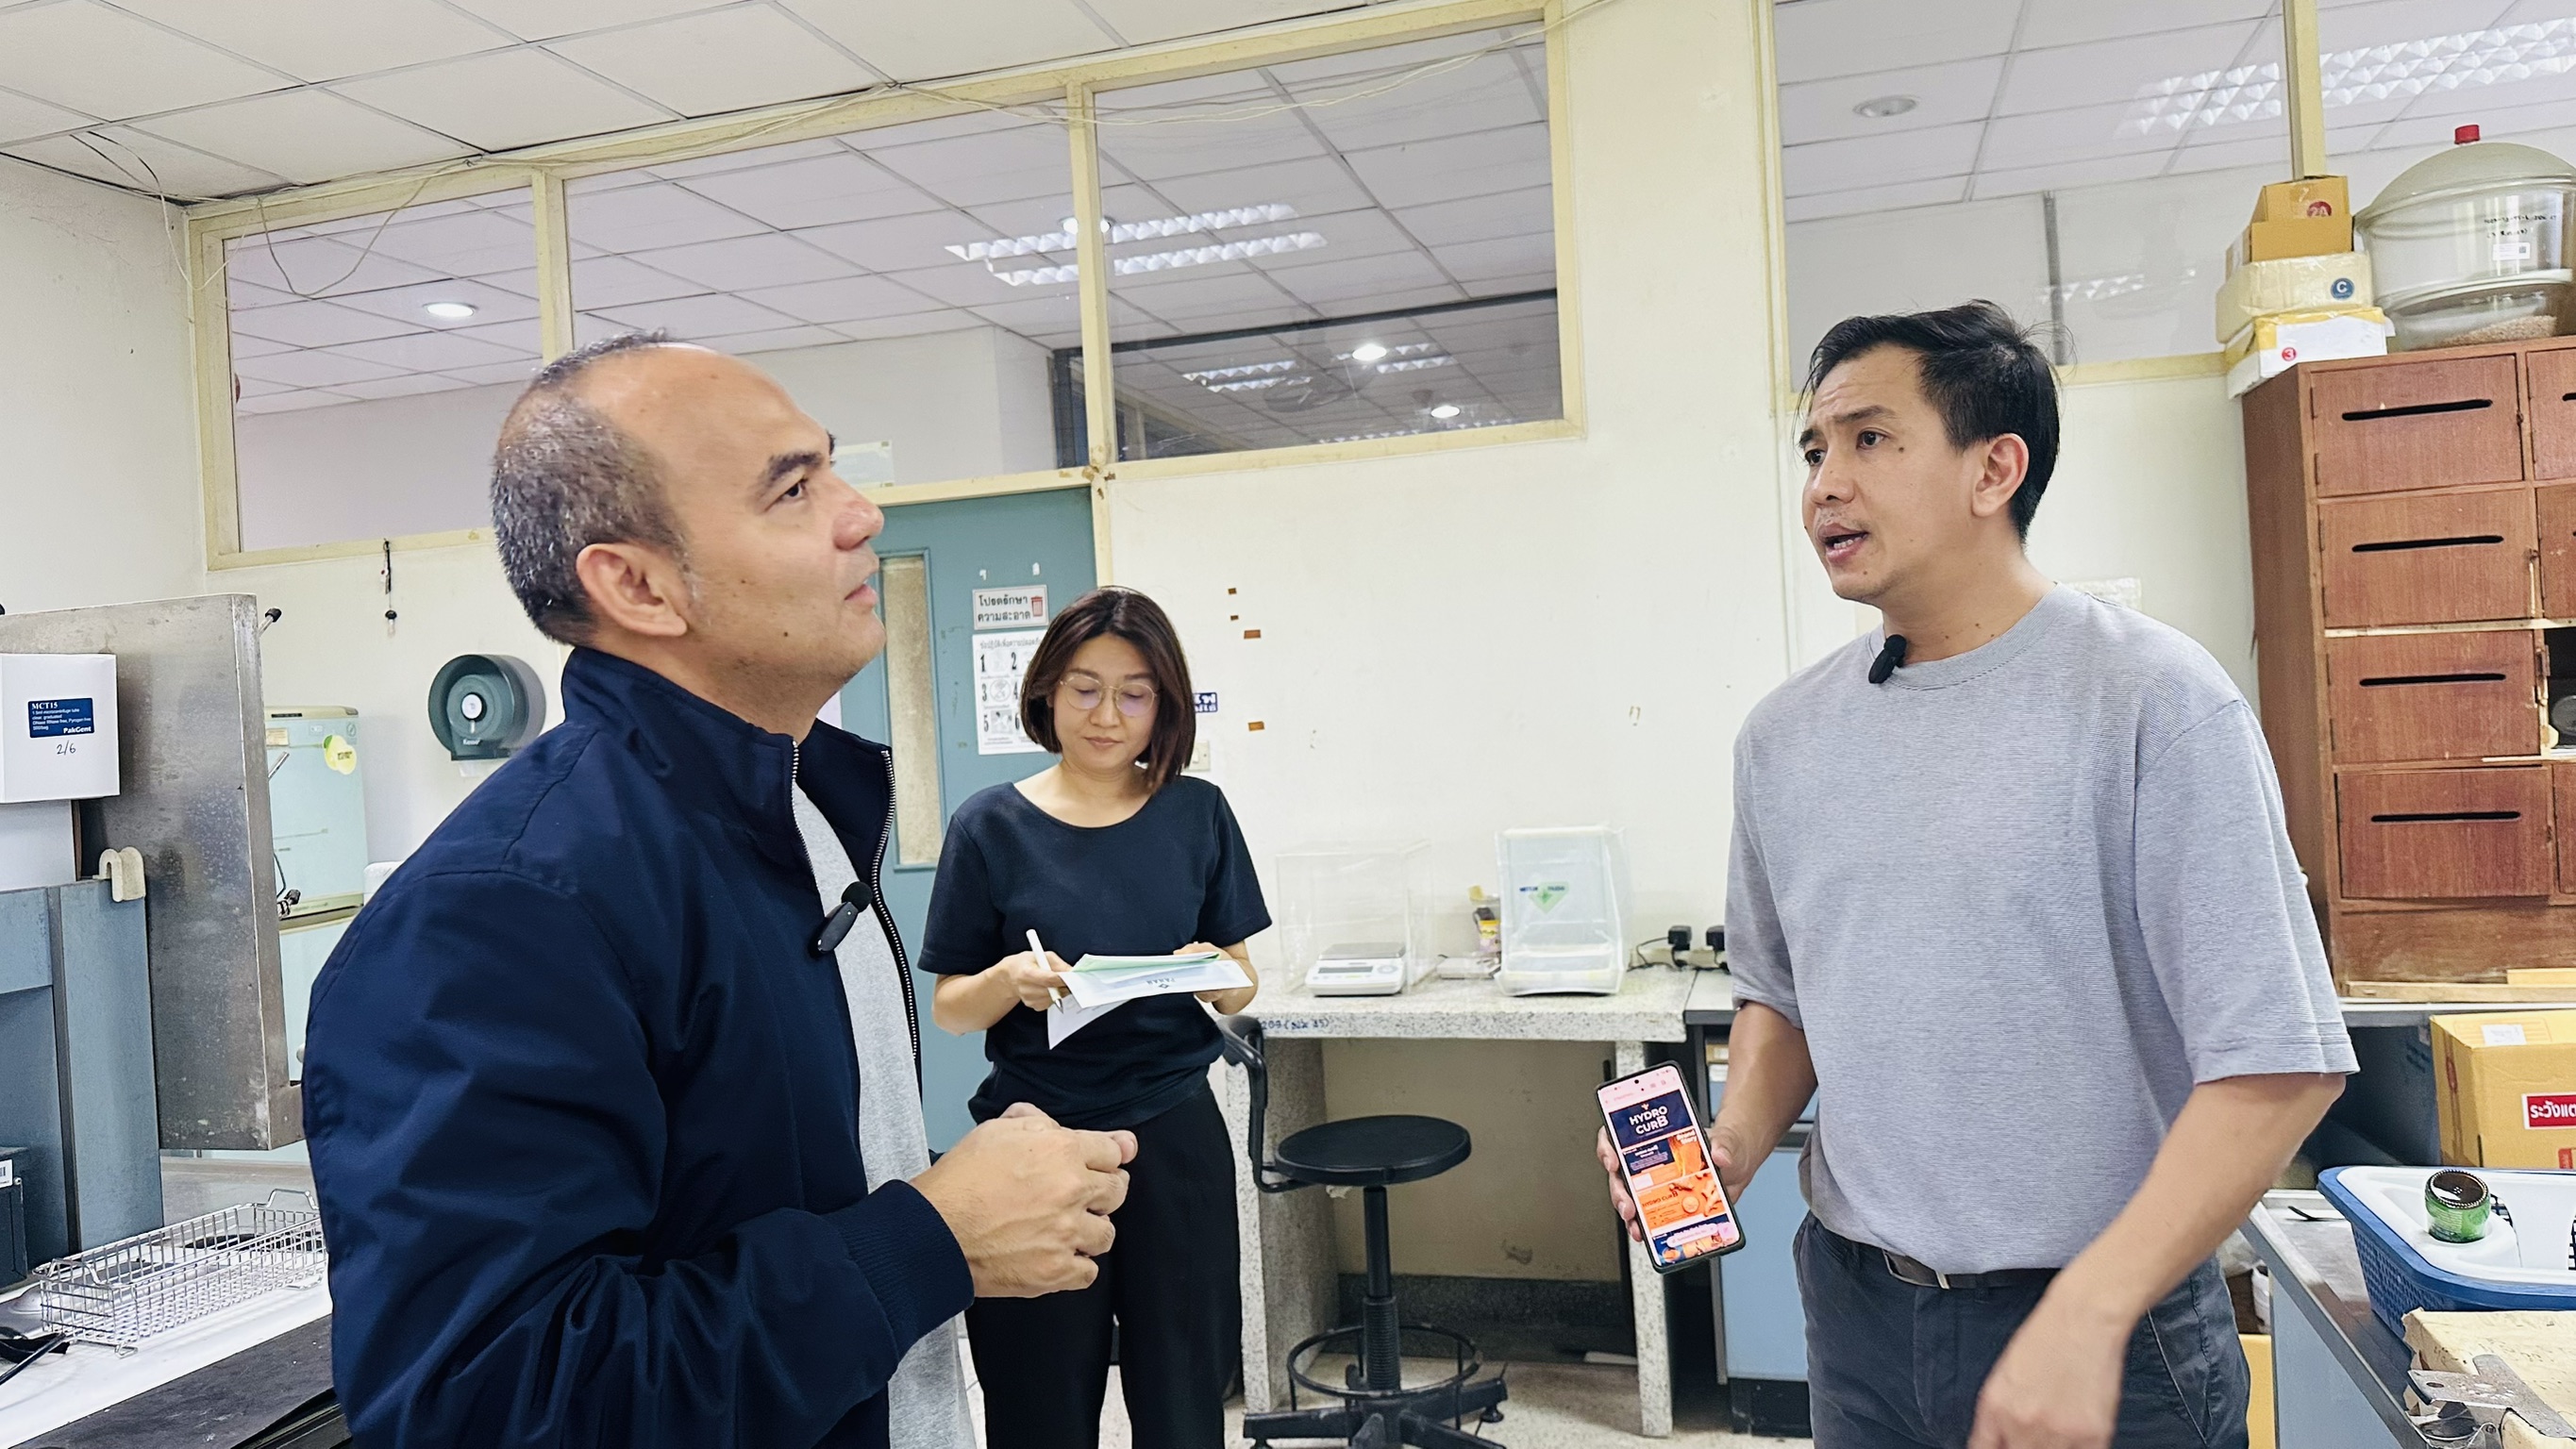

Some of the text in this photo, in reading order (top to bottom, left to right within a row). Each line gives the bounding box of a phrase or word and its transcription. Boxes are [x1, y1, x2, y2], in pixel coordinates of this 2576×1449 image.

[2336, 281, 2348, 293] C
[2284, 349, 2294, 360] 3
[979, 593, 1029, 607] โปรดรักษา
[978, 610, 1031, 623] ความสะอาด
[980, 654, 986, 673] 1
[1011, 652, 1017, 671] 2
[981, 683, 988, 702] 3
[1013, 681, 1018, 700] 4
[983, 714, 989, 732] 5
[1014, 712, 1020, 730] 6
[57, 740, 76, 756] 2/6
[1629, 1106, 1668, 1125] HYDRO
[1635, 1115, 1669, 1135] CURB
